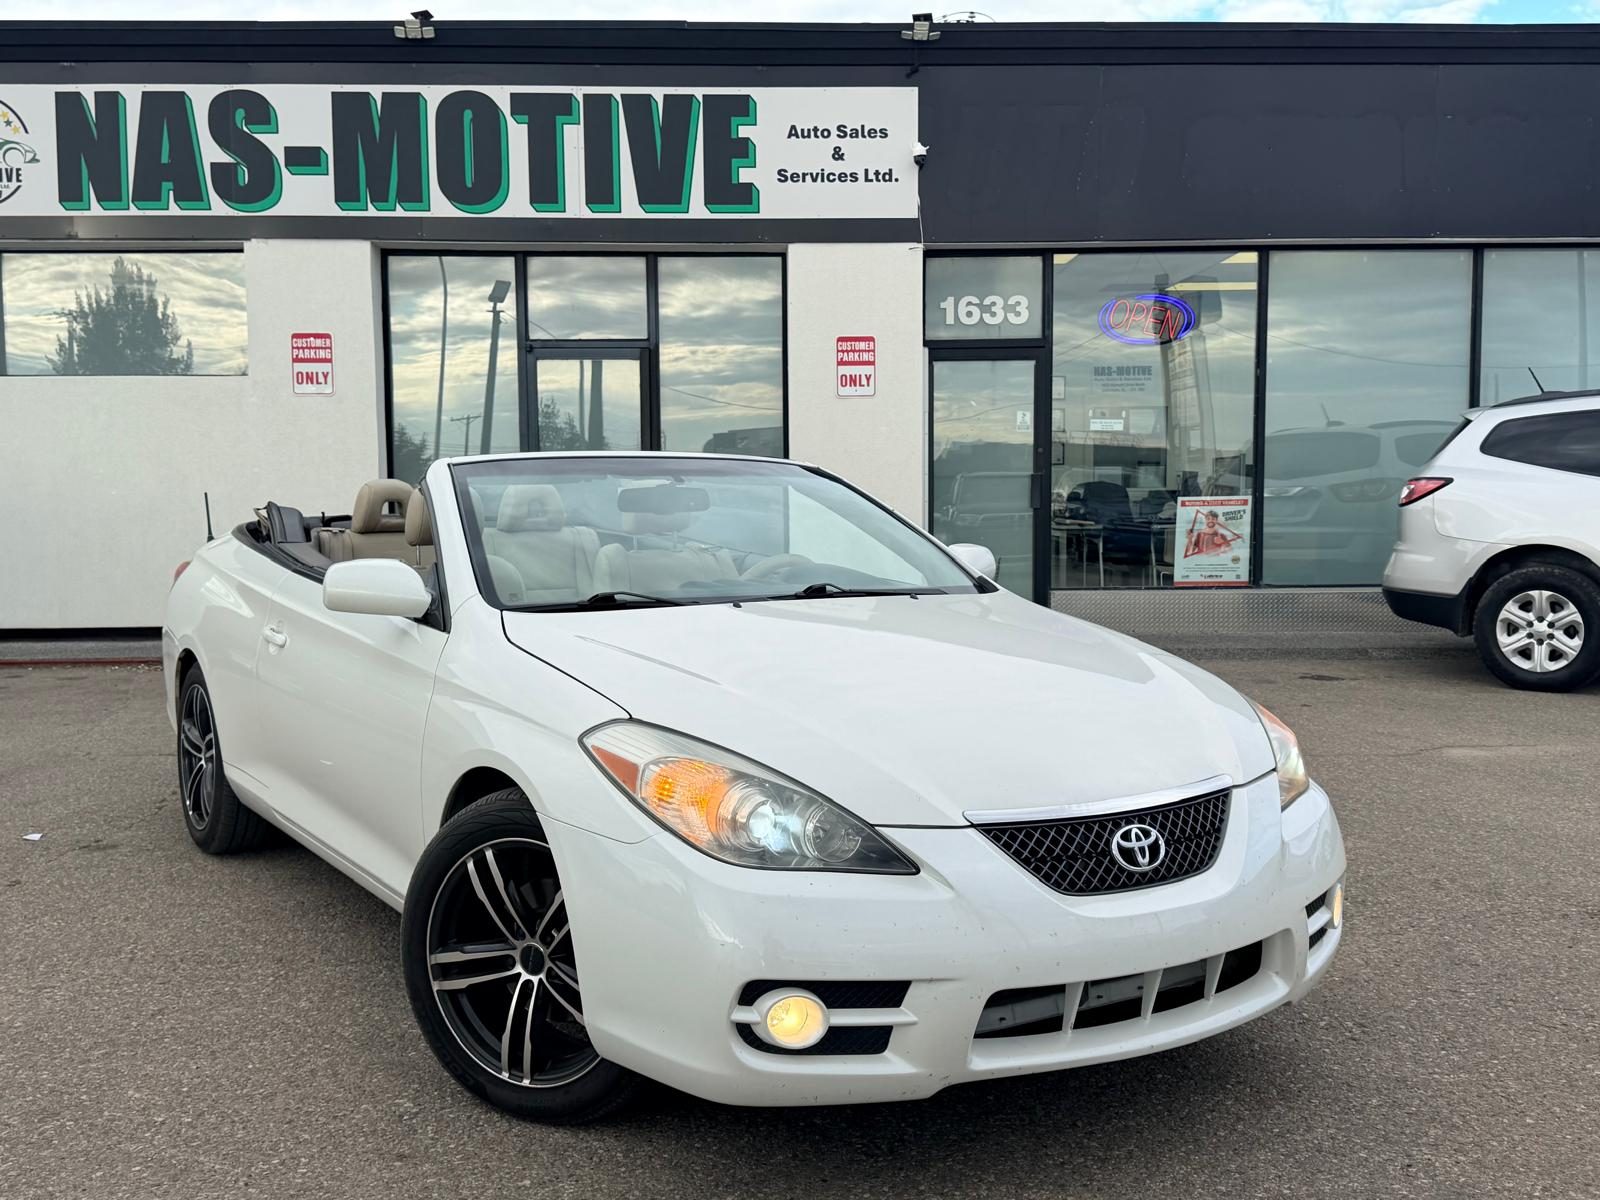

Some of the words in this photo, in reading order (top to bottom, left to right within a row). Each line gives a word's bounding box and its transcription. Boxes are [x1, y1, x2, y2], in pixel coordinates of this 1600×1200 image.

[787, 124, 832, 140] Auto
[836, 124, 889, 140] Sales
[55, 89, 760, 215] NAS-MOTIVE
[831, 145, 846, 162] &
[776, 168, 859, 183] Services
[863, 168, 900, 183] Ltd.
[939, 295, 1030, 325] 1633
[1109, 299, 1182, 339] OPEN
[292, 338, 331, 347] CUSTOMER
[837, 341, 874, 350] CUSTOMER
[293, 349, 331, 359] PARKING
[837, 351, 874, 361] PARKING
[296, 371, 329, 385] ONLY
[1093, 365, 1153, 377] NAS-MOTIVE
[840, 374, 872, 387] ONLY
